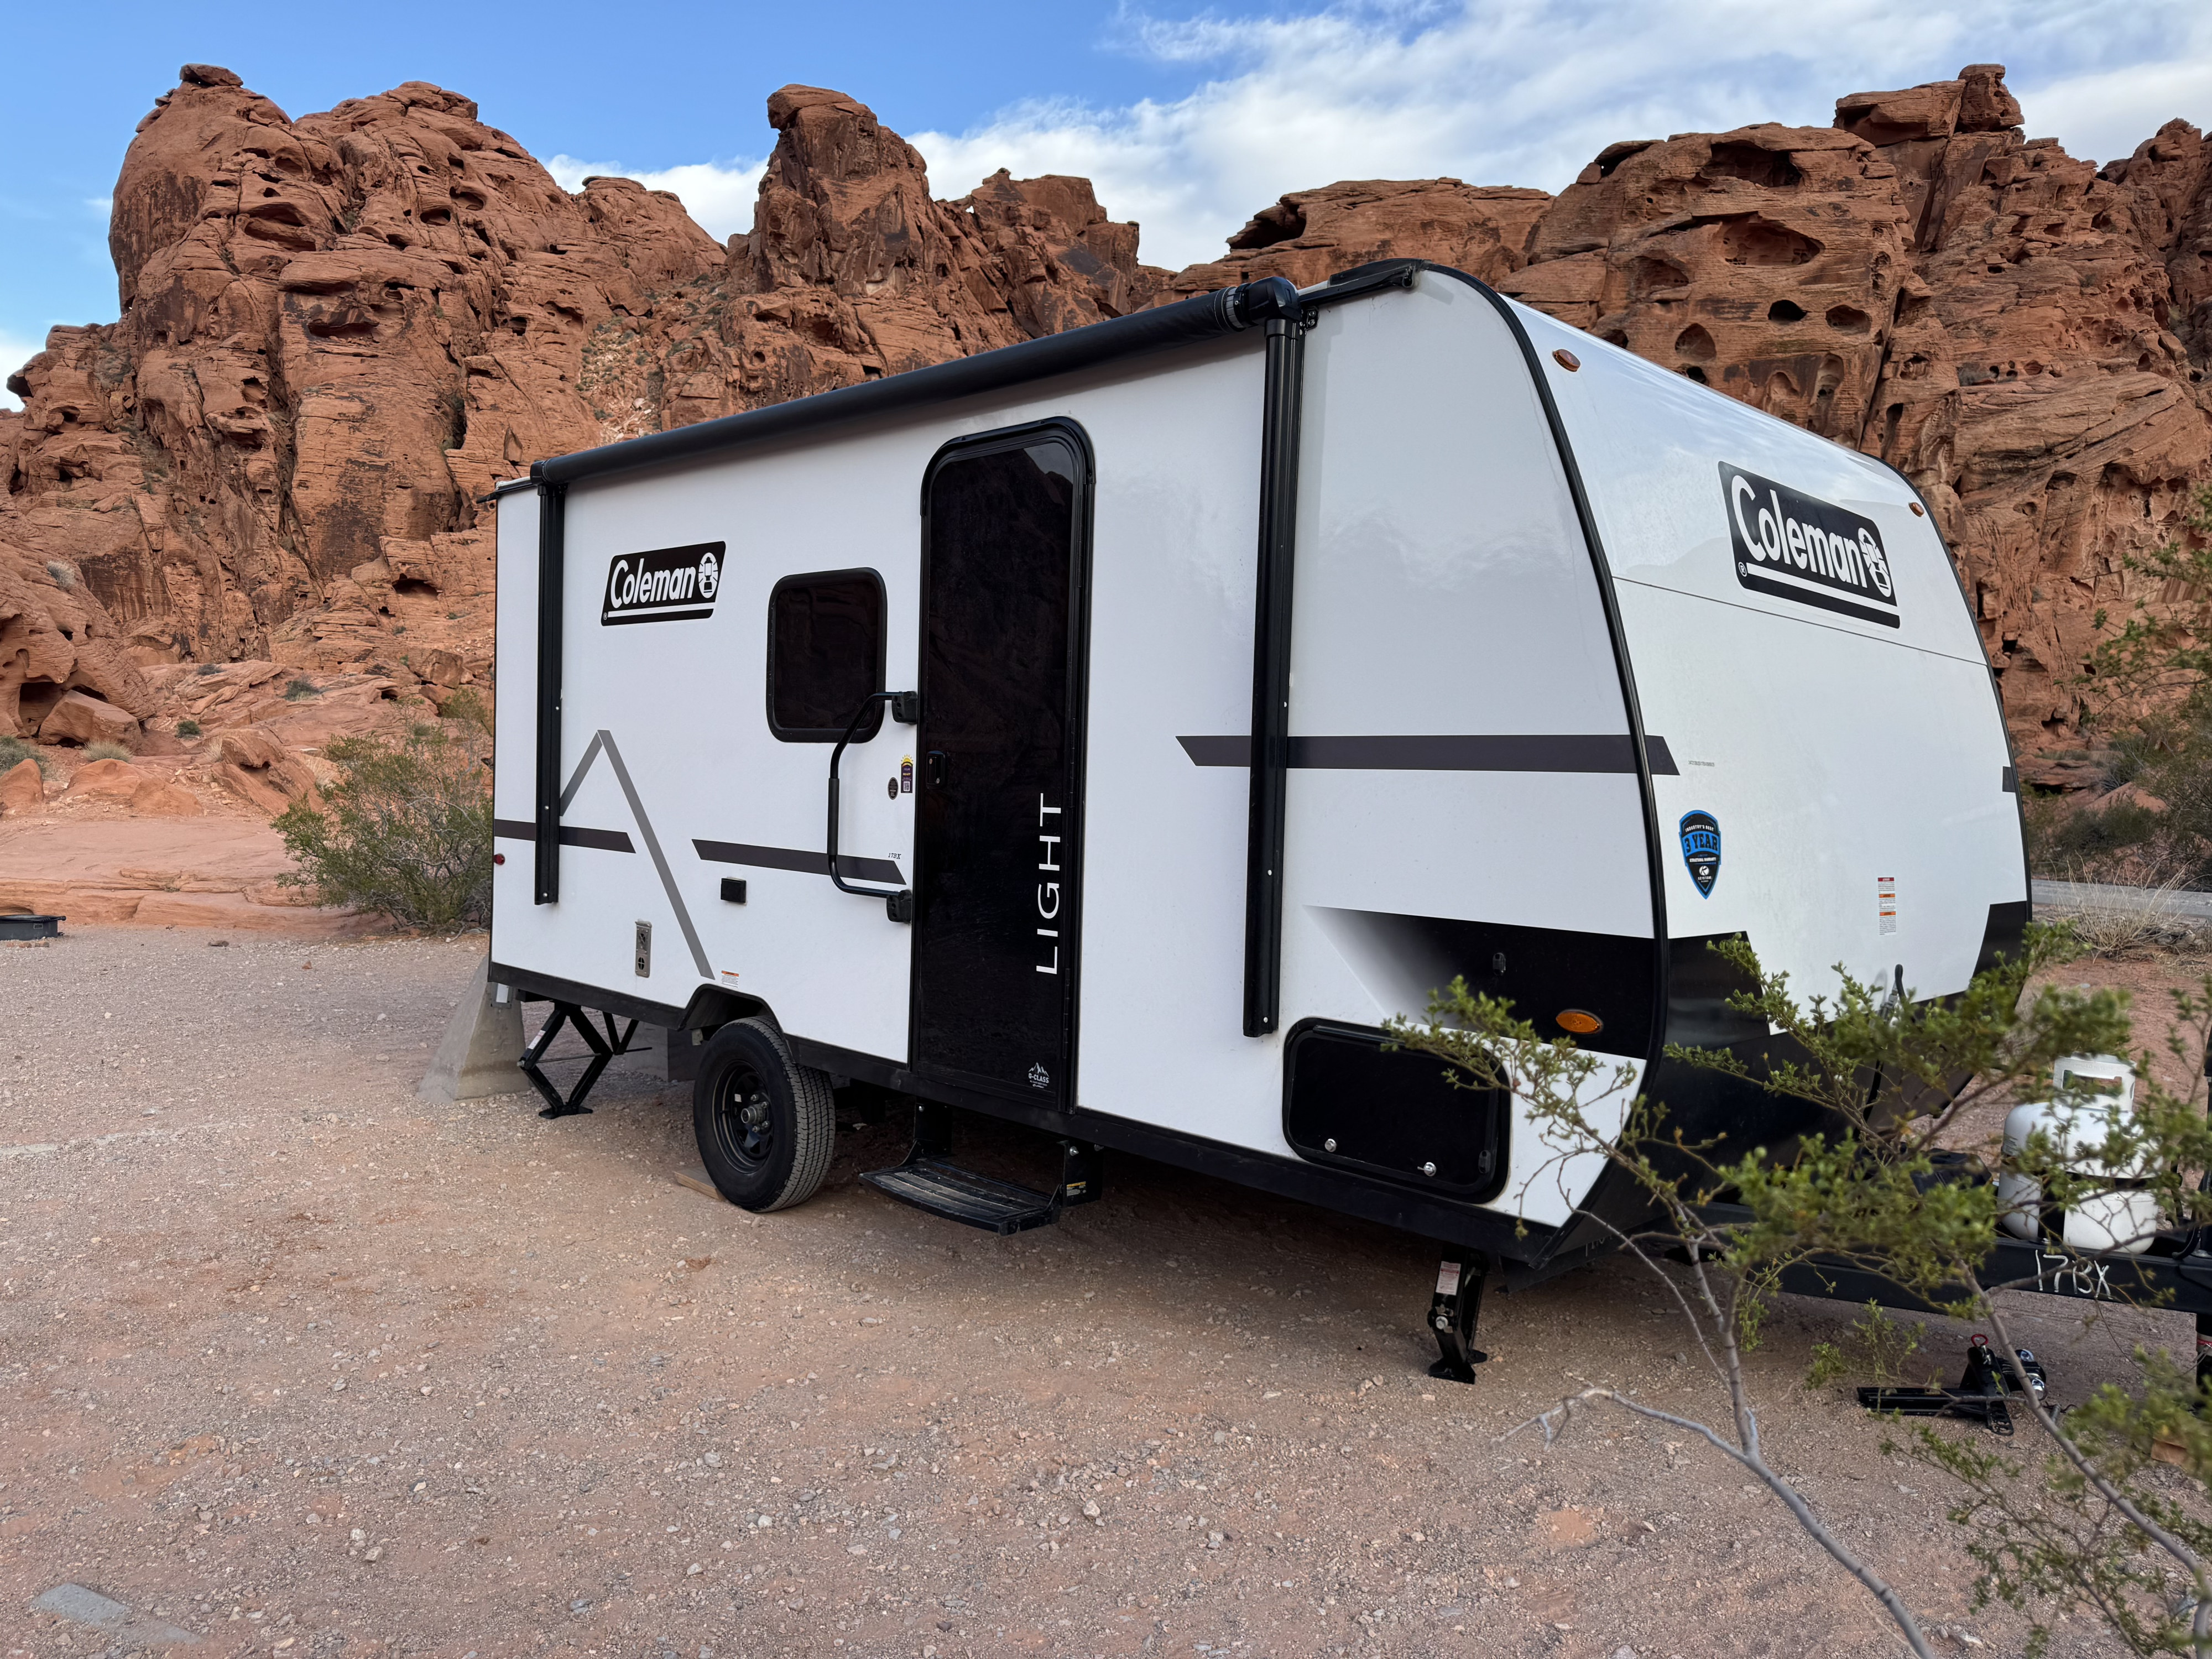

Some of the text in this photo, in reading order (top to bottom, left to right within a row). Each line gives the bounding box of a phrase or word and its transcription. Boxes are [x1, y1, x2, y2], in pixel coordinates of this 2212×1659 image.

[1731, 474, 1867, 588] Coleman
[611, 558, 696, 608] Coleman
[1684, 833, 1718, 853] 3 YEAR
[1036, 792, 1061, 974] LIGHT
[1028, 1073, 1049, 1083] G-CLASS
[2035, 1249, 2114, 1300] 17BX
